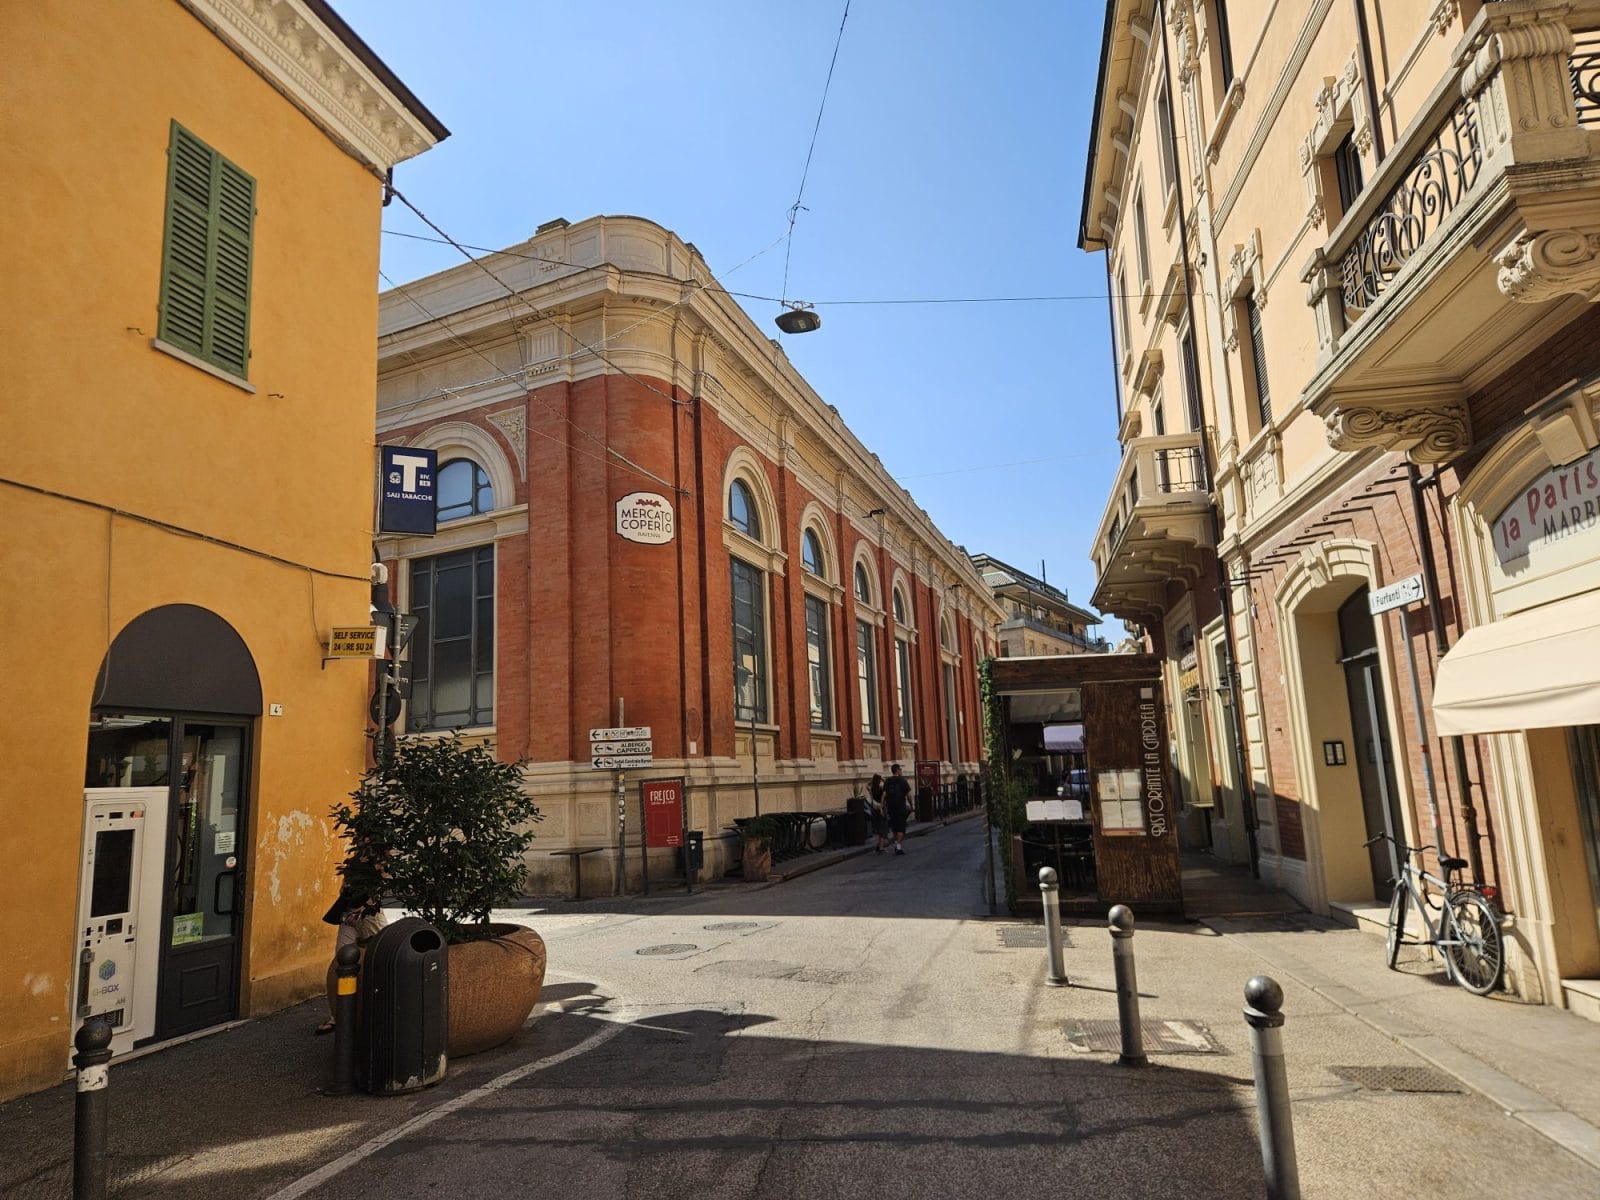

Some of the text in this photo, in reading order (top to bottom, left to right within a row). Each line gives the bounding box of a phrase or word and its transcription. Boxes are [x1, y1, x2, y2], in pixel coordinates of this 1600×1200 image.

[393, 454, 428, 492] T
[402, 492, 432, 500] TABACCHI
[621, 508, 672, 524] MERCATO
[1543, 495, 1600, 545] MARB
[621, 519, 672, 533] COPERTO
[1501, 517, 1521, 549] la
[333, 643, 341, 651] 24
[355, 643, 365, 651] SU
[366, 643, 373, 651] 24
[1144, 752, 1160, 765] LA
[650, 789, 675, 804] FRESCO
[1145, 767, 1168, 837] RISTORANTE
